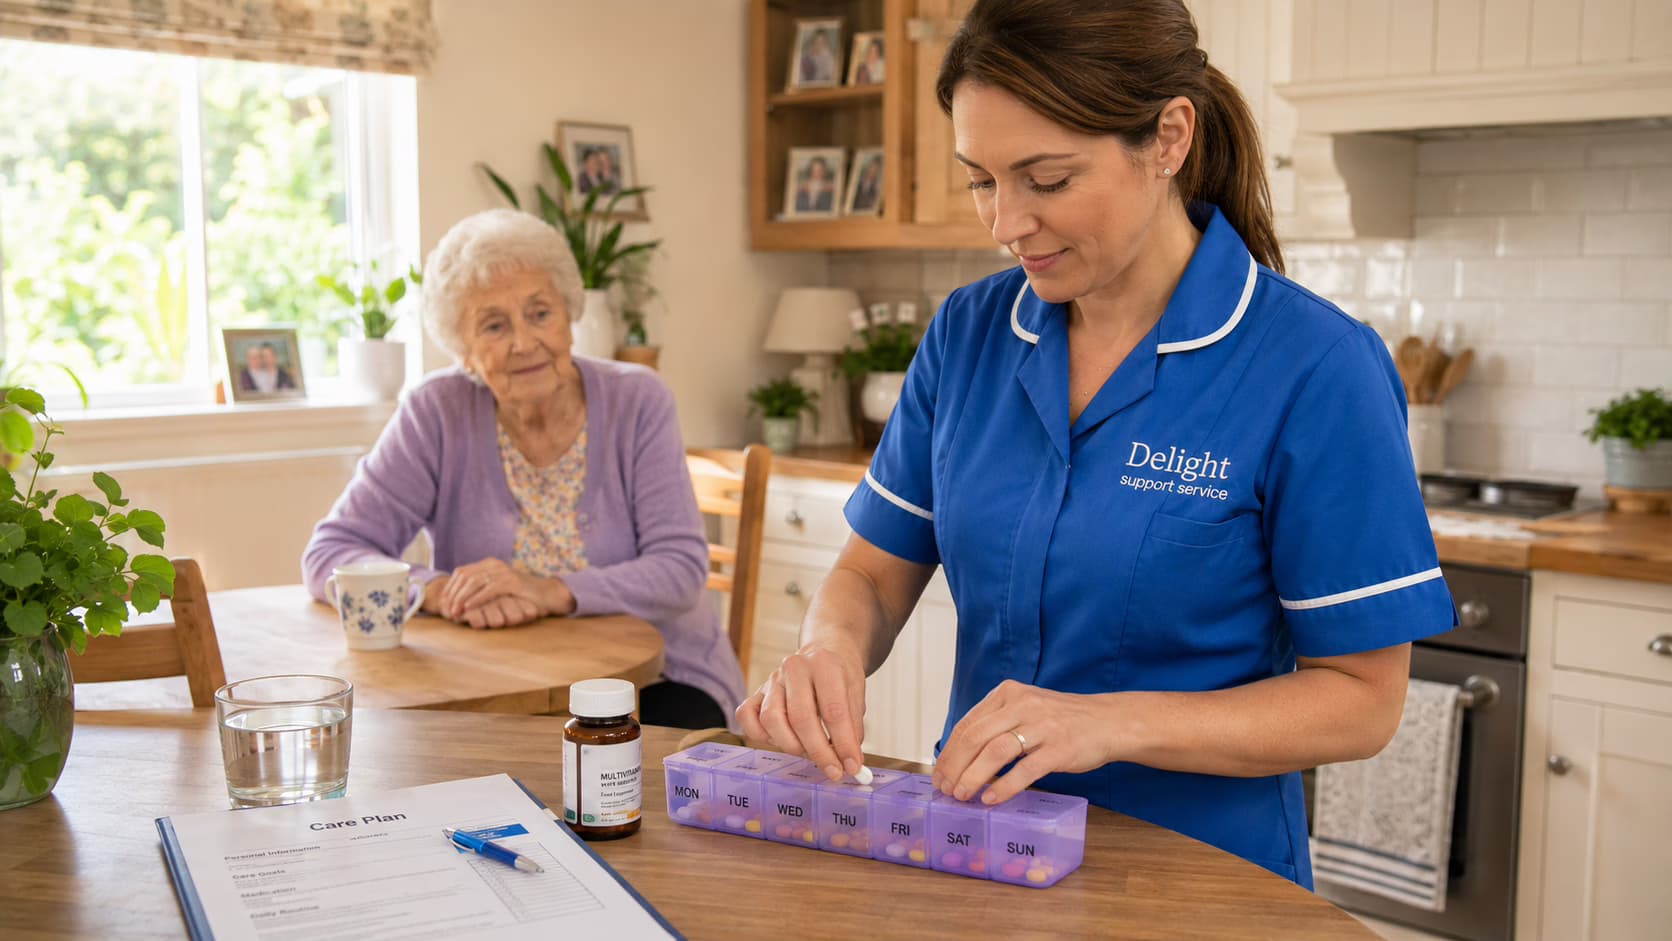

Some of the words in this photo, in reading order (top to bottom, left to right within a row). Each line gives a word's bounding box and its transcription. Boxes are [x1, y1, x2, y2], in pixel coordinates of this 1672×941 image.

[1125, 441, 1231, 482] Delight
[1120, 474, 1175, 493] support
[1176, 483, 1228, 501] service
[674, 785, 700, 800] MON
[727, 794, 750, 808] TUE
[777, 803, 804, 818] WED
[309, 818, 357, 832] Care
[362, 812, 407, 825] Plan
[832, 812, 857, 827] THU
[890, 822, 911, 836] FRI
[946, 831, 971, 847] SAT
[1006, 841, 1035, 857] SUN
